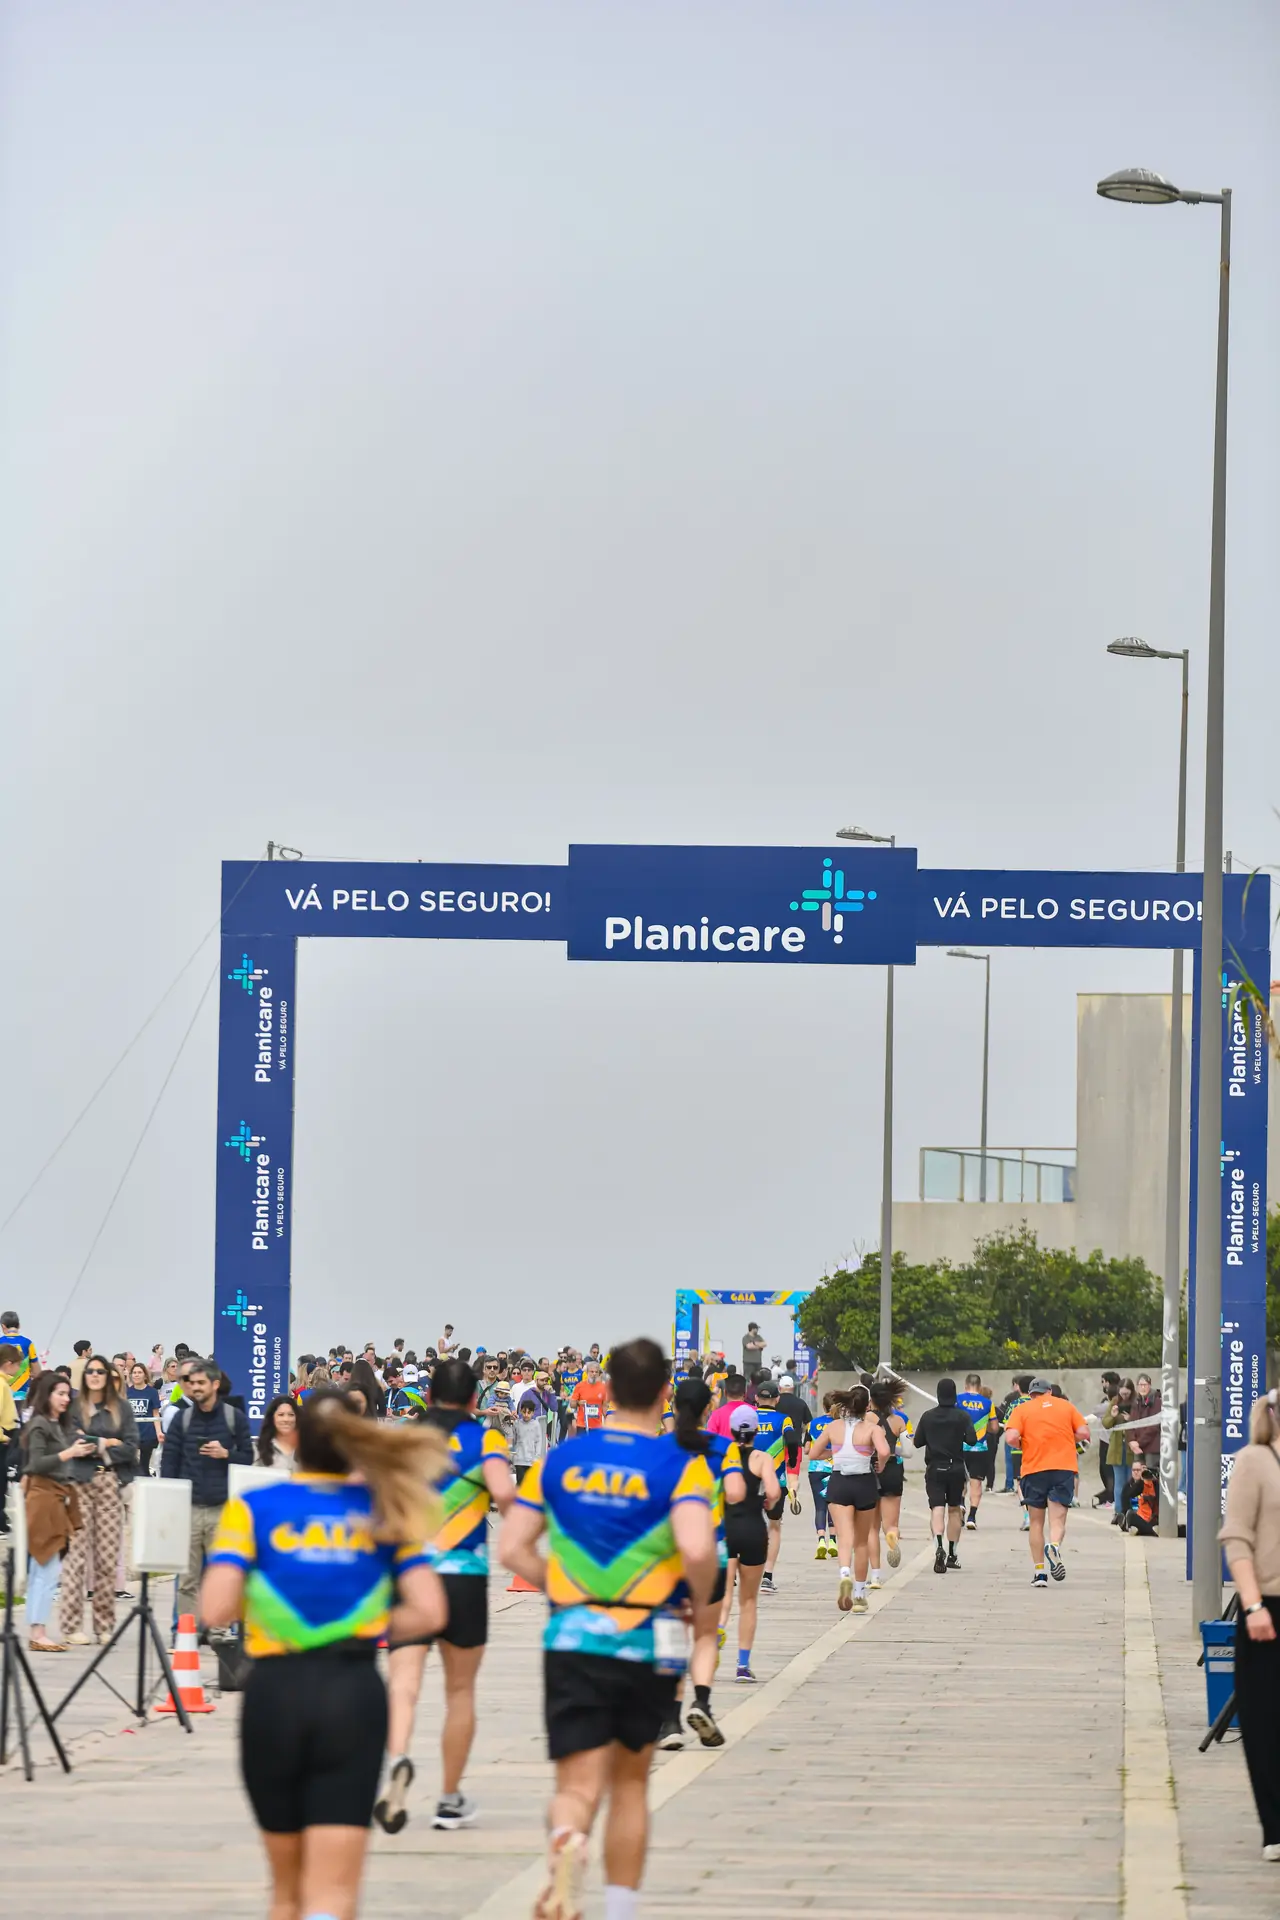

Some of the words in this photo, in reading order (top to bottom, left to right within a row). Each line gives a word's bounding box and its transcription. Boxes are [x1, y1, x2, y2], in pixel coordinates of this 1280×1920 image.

[284, 884, 323, 911] VÁ
[332, 890, 410, 912] PELO
[419, 891, 551, 914] SEGURO!
[933, 892, 971, 919] VÁ
[981, 898, 1059, 920] PELO
[1069, 899, 1203, 922] SEGURO!
[605, 915, 806, 953] Planicare
[279, 1000, 288, 1034] SEGURO
[1254, 1014, 1263, 1049] SEGURO
[254, 986, 273, 1083] Planicare
[279, 1036, 287, 1058] PELO
[277, 1060, 287, 1070] VÁ
[1254, 1050, 1262, 1072] PELO
[1253, 1074, 1262, 1085] VÁ
[276, 1167, 285, 1202] SEGURO
[1252, 1182, 1260, 1217] SEGURO
[251, 1153, 270, 1250] Planicare
[276, 1203, 285, 1225] PELO
[275, 1226, 284, 1237] VÁ
[1226, 1168, 1245, 1266] Planicare
[1251, 1219, 1260, 1241] PELO
[1250, 1243, 1259, 1254] VÁ
[730, 1292, 757, 1302] GAIA
[273, 1336, 282, 1371] SEGURO
[248, 1322, 268, 1420] Planicare
[272, 1372, 281, 1394] PELO
[1251, 1354, 1259, 1389] SEGURO
[1225, 1339, 1244, 1438] Planicare
[1251, 1390, 1259, 1407] ELO
[962, 1400, 984, 1410] GAIA
[562, 1466, 650, 1500] GAIA
